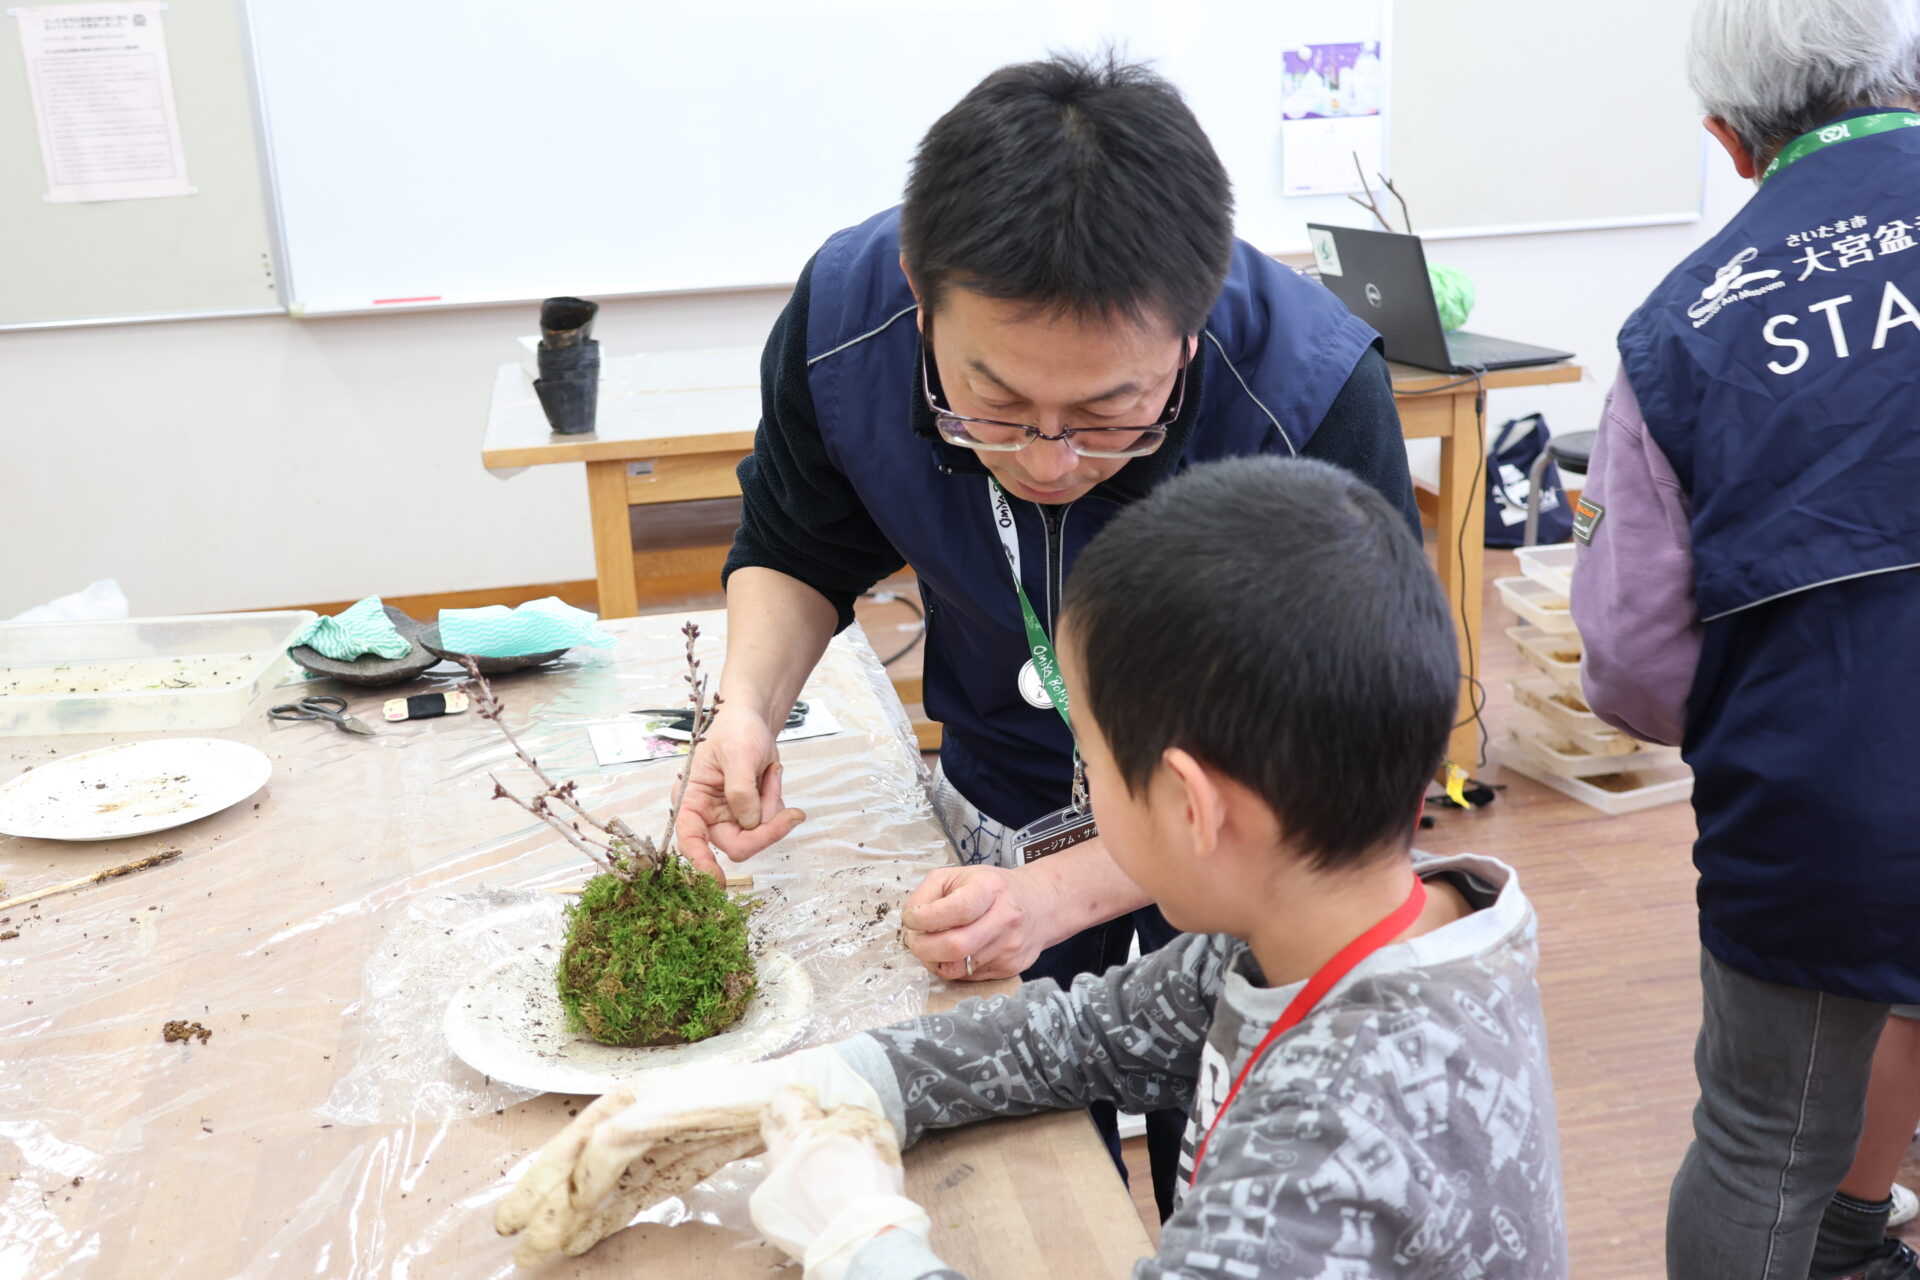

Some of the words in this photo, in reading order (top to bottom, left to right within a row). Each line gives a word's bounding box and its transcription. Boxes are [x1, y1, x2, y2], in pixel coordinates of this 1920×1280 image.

[1785, 215, 1868, 247] さいたま市
[1792, 214, 1920, 281] 大宮盆
